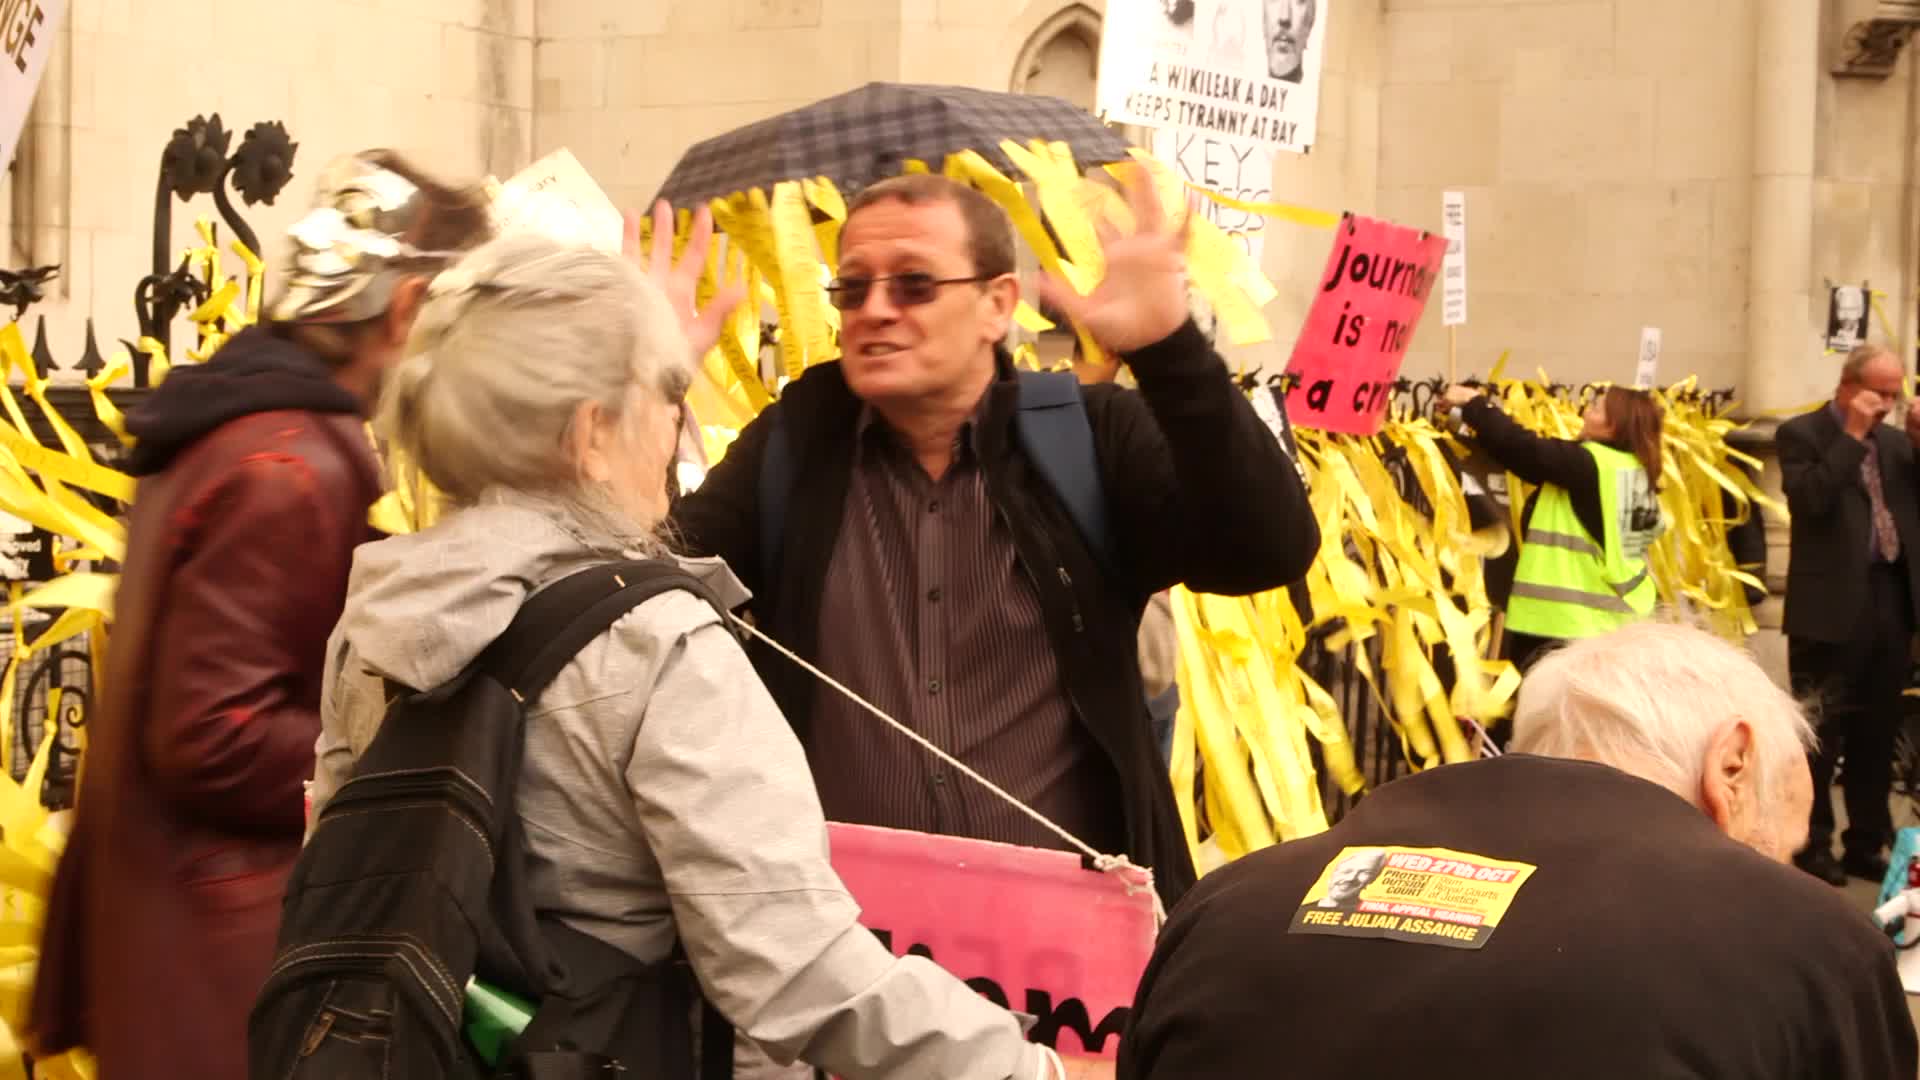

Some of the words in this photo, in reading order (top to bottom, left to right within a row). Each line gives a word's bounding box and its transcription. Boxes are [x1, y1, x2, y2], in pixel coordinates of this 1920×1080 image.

[1150, 62, 1158, 84] A
[1168, 64, 1242, 102] WIKILEAK
[1245, 81, 1254, 106] A
[1260, 84, 1289, 113] DAY
[1125, 92, 1172, 122] KEEPS
[1178, 101, 1249, 137] TYRANNY
[1250, 116, 1269, 140] AT
[1271, 121, 1298, 145] BAY
[1176, 131, 1255, 190] KEY
[1333, 301, 1365, 348] is
[1306, 379, 1334, 413] a
[1381, 877, 1427, 889] OUTSIDE
[1384, 870, 1433, 883] PROTEST
[1388, 853, 1432, 870] WED
[1429, 858, 1475, 878] 27th
[1474, 867, 1518, 883] OCT
[1386, 886, 1424, 898] COURT
[1434, 882, 1465, 895] Royal
[1465, 885, 1500, 901] Courts
[1441, 892, 1479, 905] Justice
[1359, 899, 1390, 912] FINAL
[1391, 903, 1432, 918] APPEAL
[1302, 910, 1343, 925] FREE
[1343, 913, 1399, 930] JULIAN
[1400, 919, 1479, 942] ASSANGE
